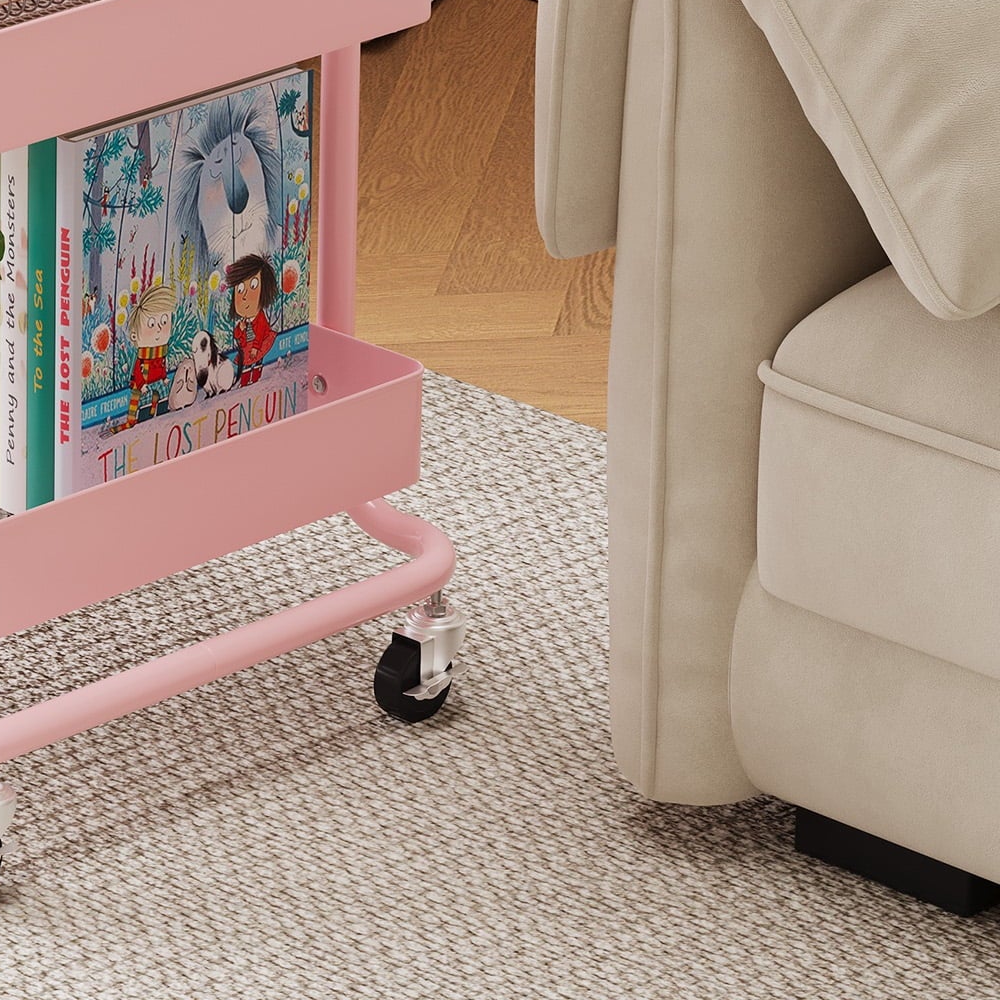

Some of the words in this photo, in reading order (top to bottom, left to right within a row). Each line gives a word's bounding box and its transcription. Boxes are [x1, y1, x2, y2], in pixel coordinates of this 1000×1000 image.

[6, 174, 16, 282] Monsters
[33, 268, 44, 310] Sea
[60, 227, 70, 327] PENGUIN
[5, 293, 15, 329] the
[33, 319, 43, 357] the
[6, 339, 15, 384] and
[33, 367, 43, 393] To
[60, 336, 70, 391] LOST
[6, 394, 18, 465] Penny
[60, 400, 70, 445] THE
[98, 439, 141, 483] THE
[153, 416, 208, 465] LOST
[214, 381, 298, 443] PENGUIN
